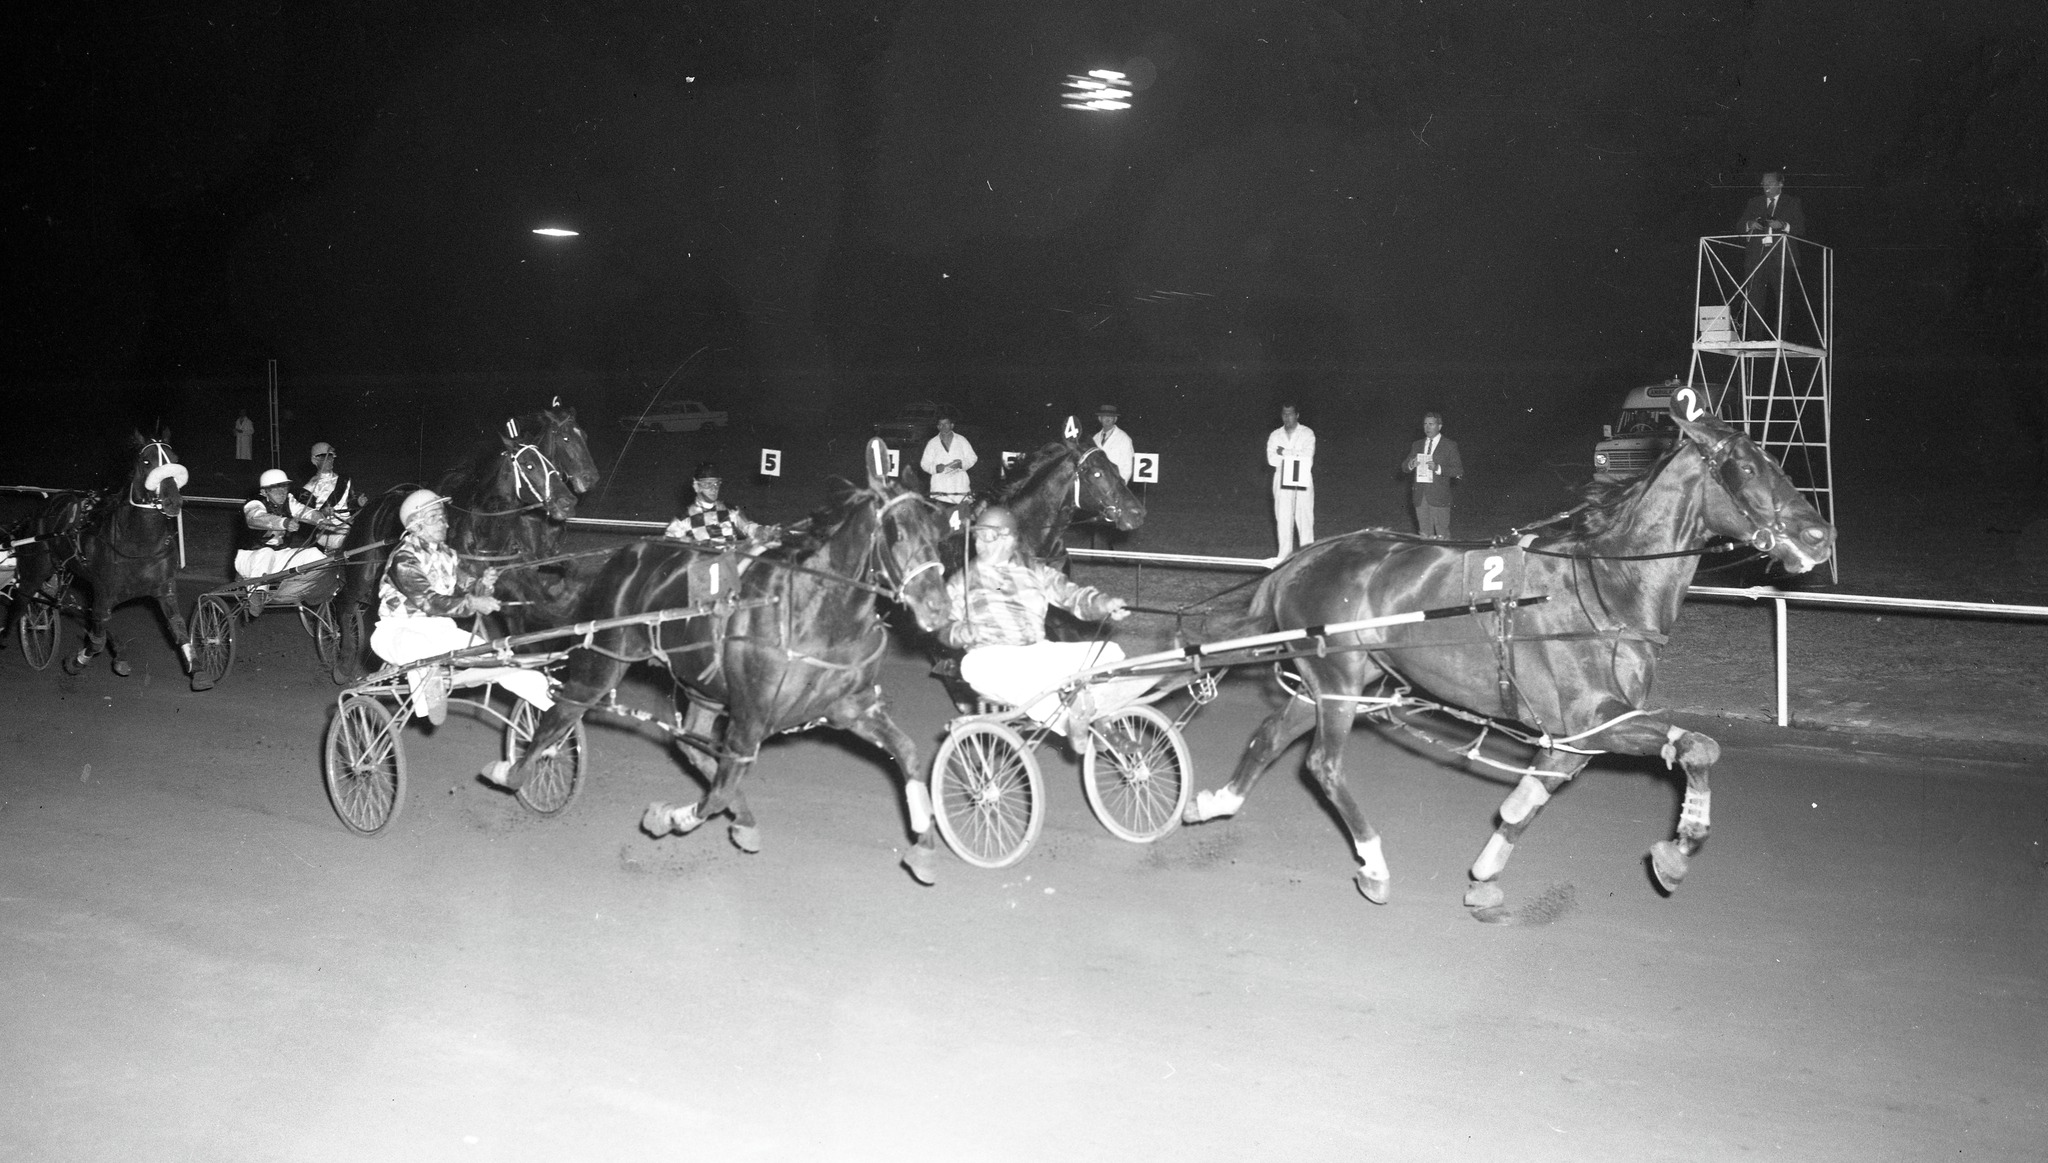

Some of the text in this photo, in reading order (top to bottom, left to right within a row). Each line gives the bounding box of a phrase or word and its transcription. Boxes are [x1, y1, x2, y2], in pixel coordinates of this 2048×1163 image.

[1676, 388, 1704, 422] 2
[506, 418, 518, 439] 11
[1064, 415, 1079, 439] 4
[764, 453, 777, 472] 5
[871, 439, 883, 476] 1
[1138, 457, 1153, 478] 2
[1292, 460, 1300, 482] 1
[948, 510, 961, 531] 4
[709, 562, 720, 595] 1
[1482, 555, 1504, 592] 2
